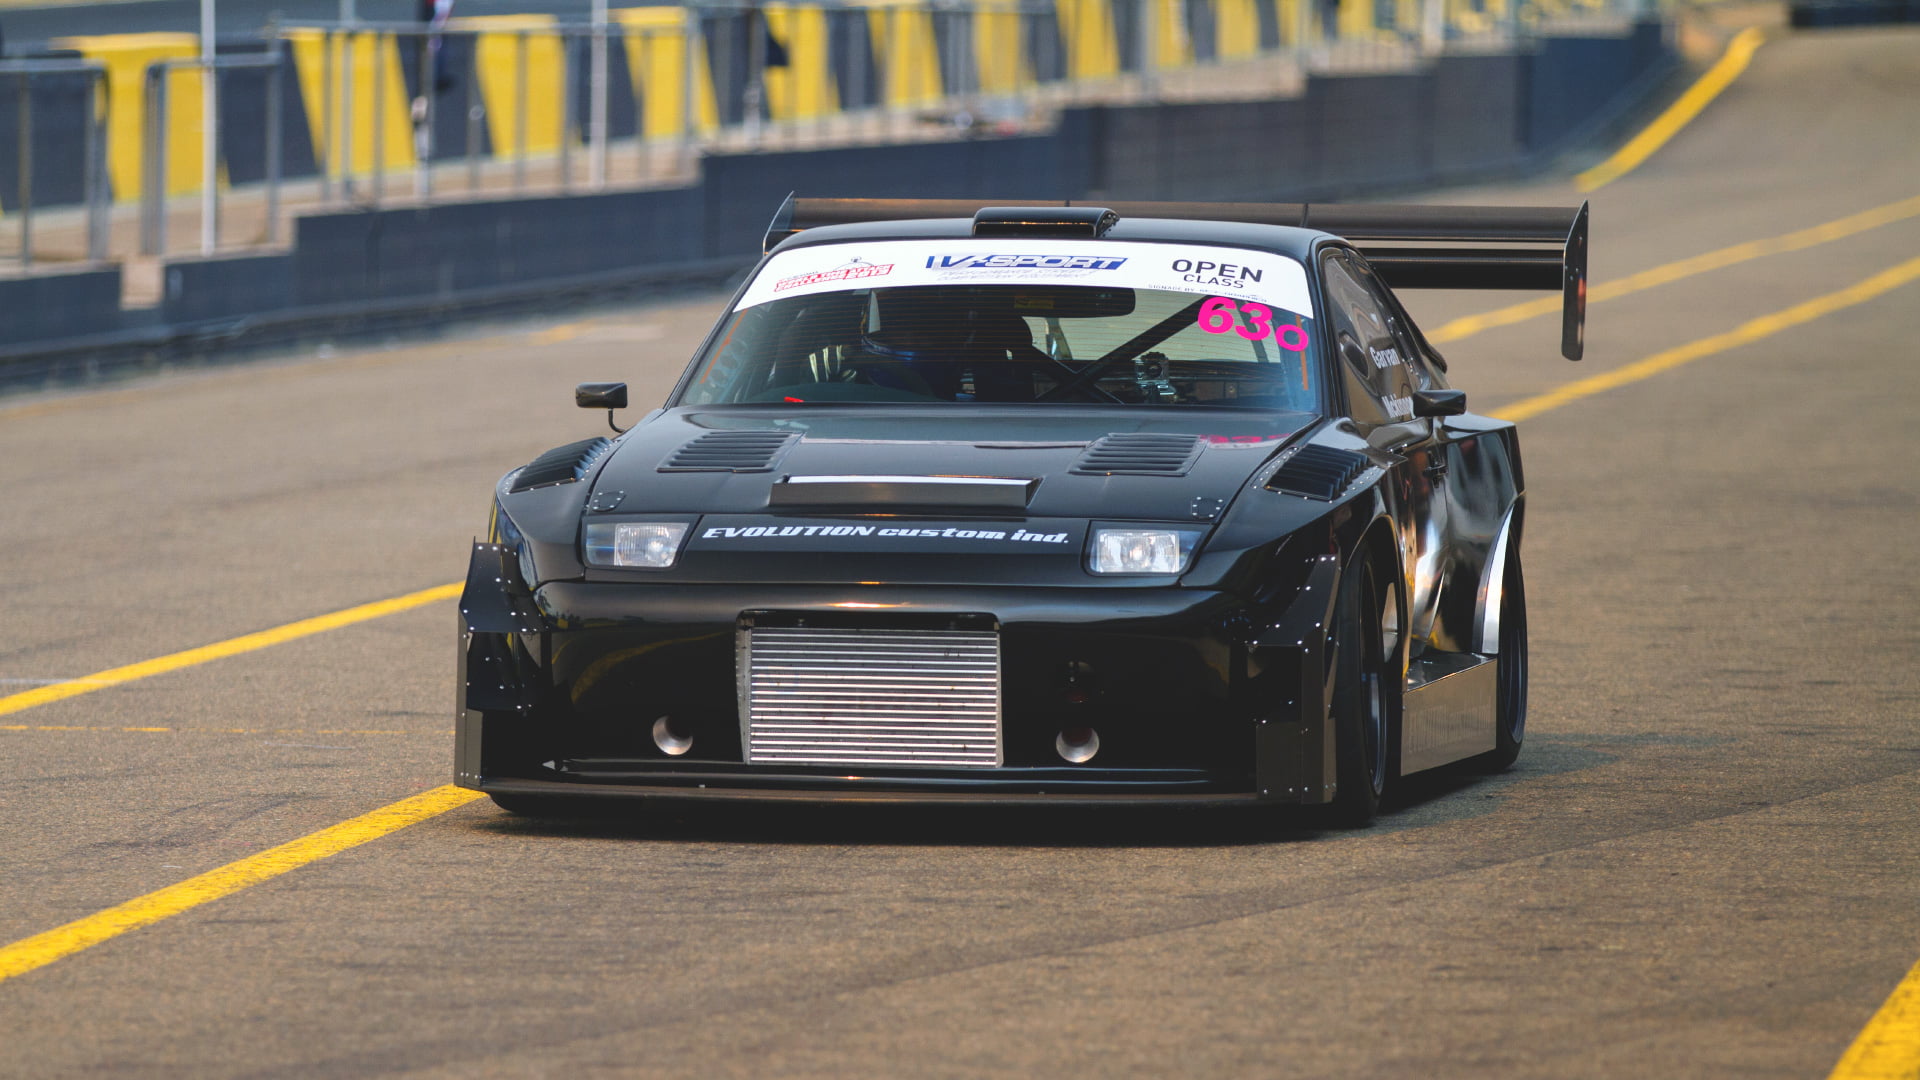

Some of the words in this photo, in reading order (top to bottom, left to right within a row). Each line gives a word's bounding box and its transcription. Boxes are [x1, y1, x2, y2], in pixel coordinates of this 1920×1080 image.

[1172, 259, 1263, 283] OPEN
[1183, 274, 1245, 289] CLASS
[1198, 296, 1273, 341] 63
[702, 526, 877, 539] EVOLUTION
[877, 527, 1005, 541] custom
[1011, 529, 1070, 544] ind.
